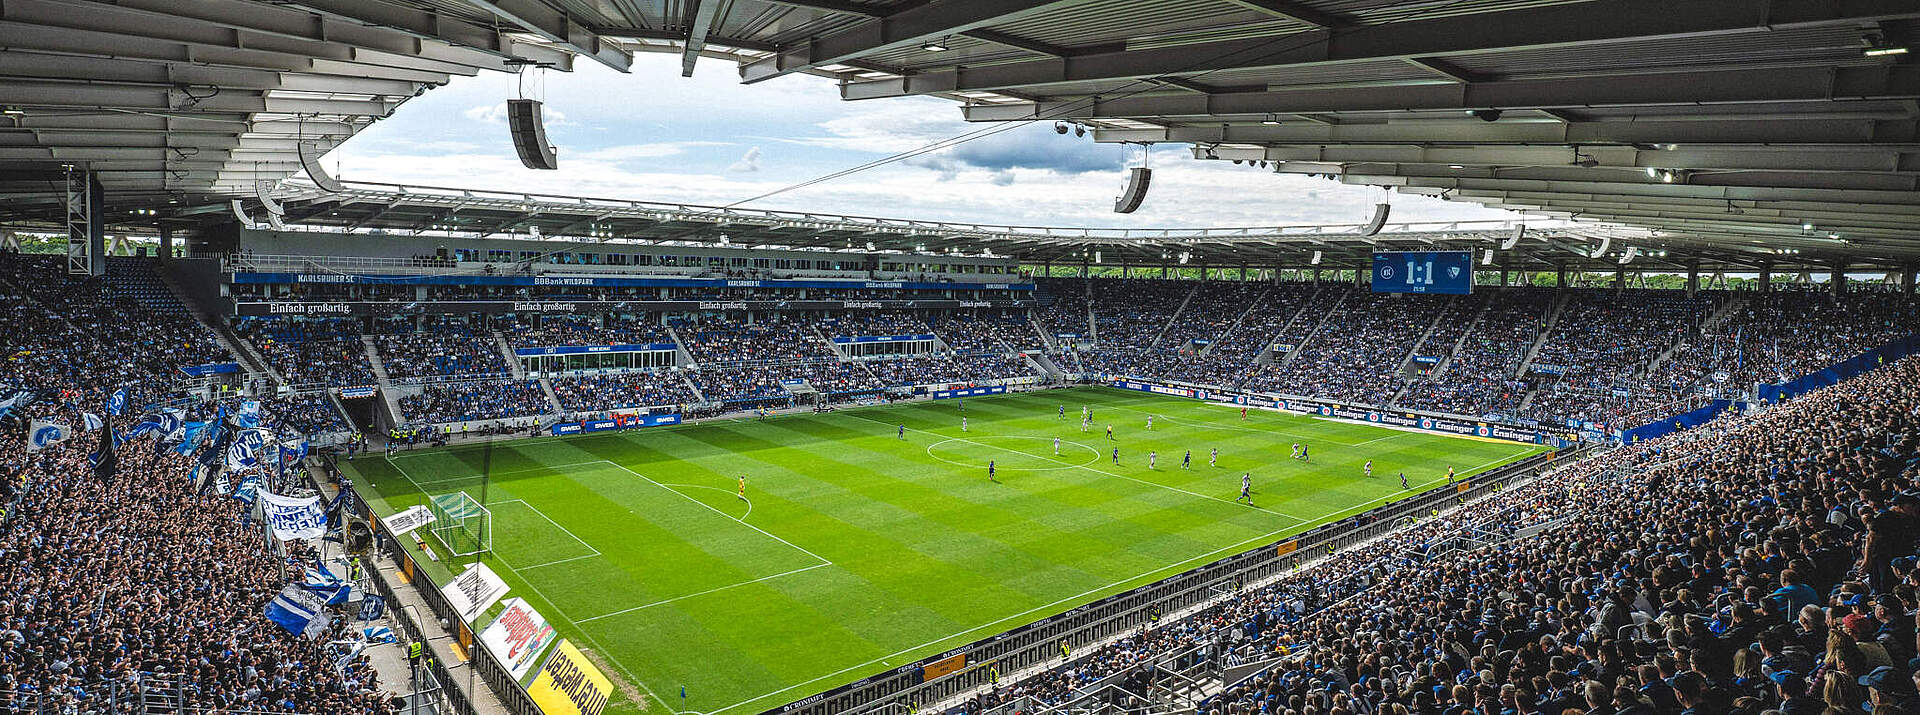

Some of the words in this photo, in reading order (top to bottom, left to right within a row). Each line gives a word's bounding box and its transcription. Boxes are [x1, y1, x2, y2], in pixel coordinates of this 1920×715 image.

[1406, 261, 1433, 284] 1:1
[298, 274, 347, 283] KARLSRUHER
[347, 275, 355, 283] SC
[270, 303, 305, 313] Einfach
[307, 303, 352, 314] großartig.
[514, 302, 541, 311] Einfach
[543, 302, 577, 312] großartig.
[699, 301, 721, 310] Einfach
[721, 302, 748, 311] großartig.
[1207, 393, 1233, 402] Ensinger
[1334, 408, 1366, 419] Ensinger
[1382, 415, 1417, 426] Ensinger
[1435, 421, 1474, 433] Ensinger
[1493, 428, 1535, 441] Ensinger
[789, 693, 825, 710] CRONIMET
